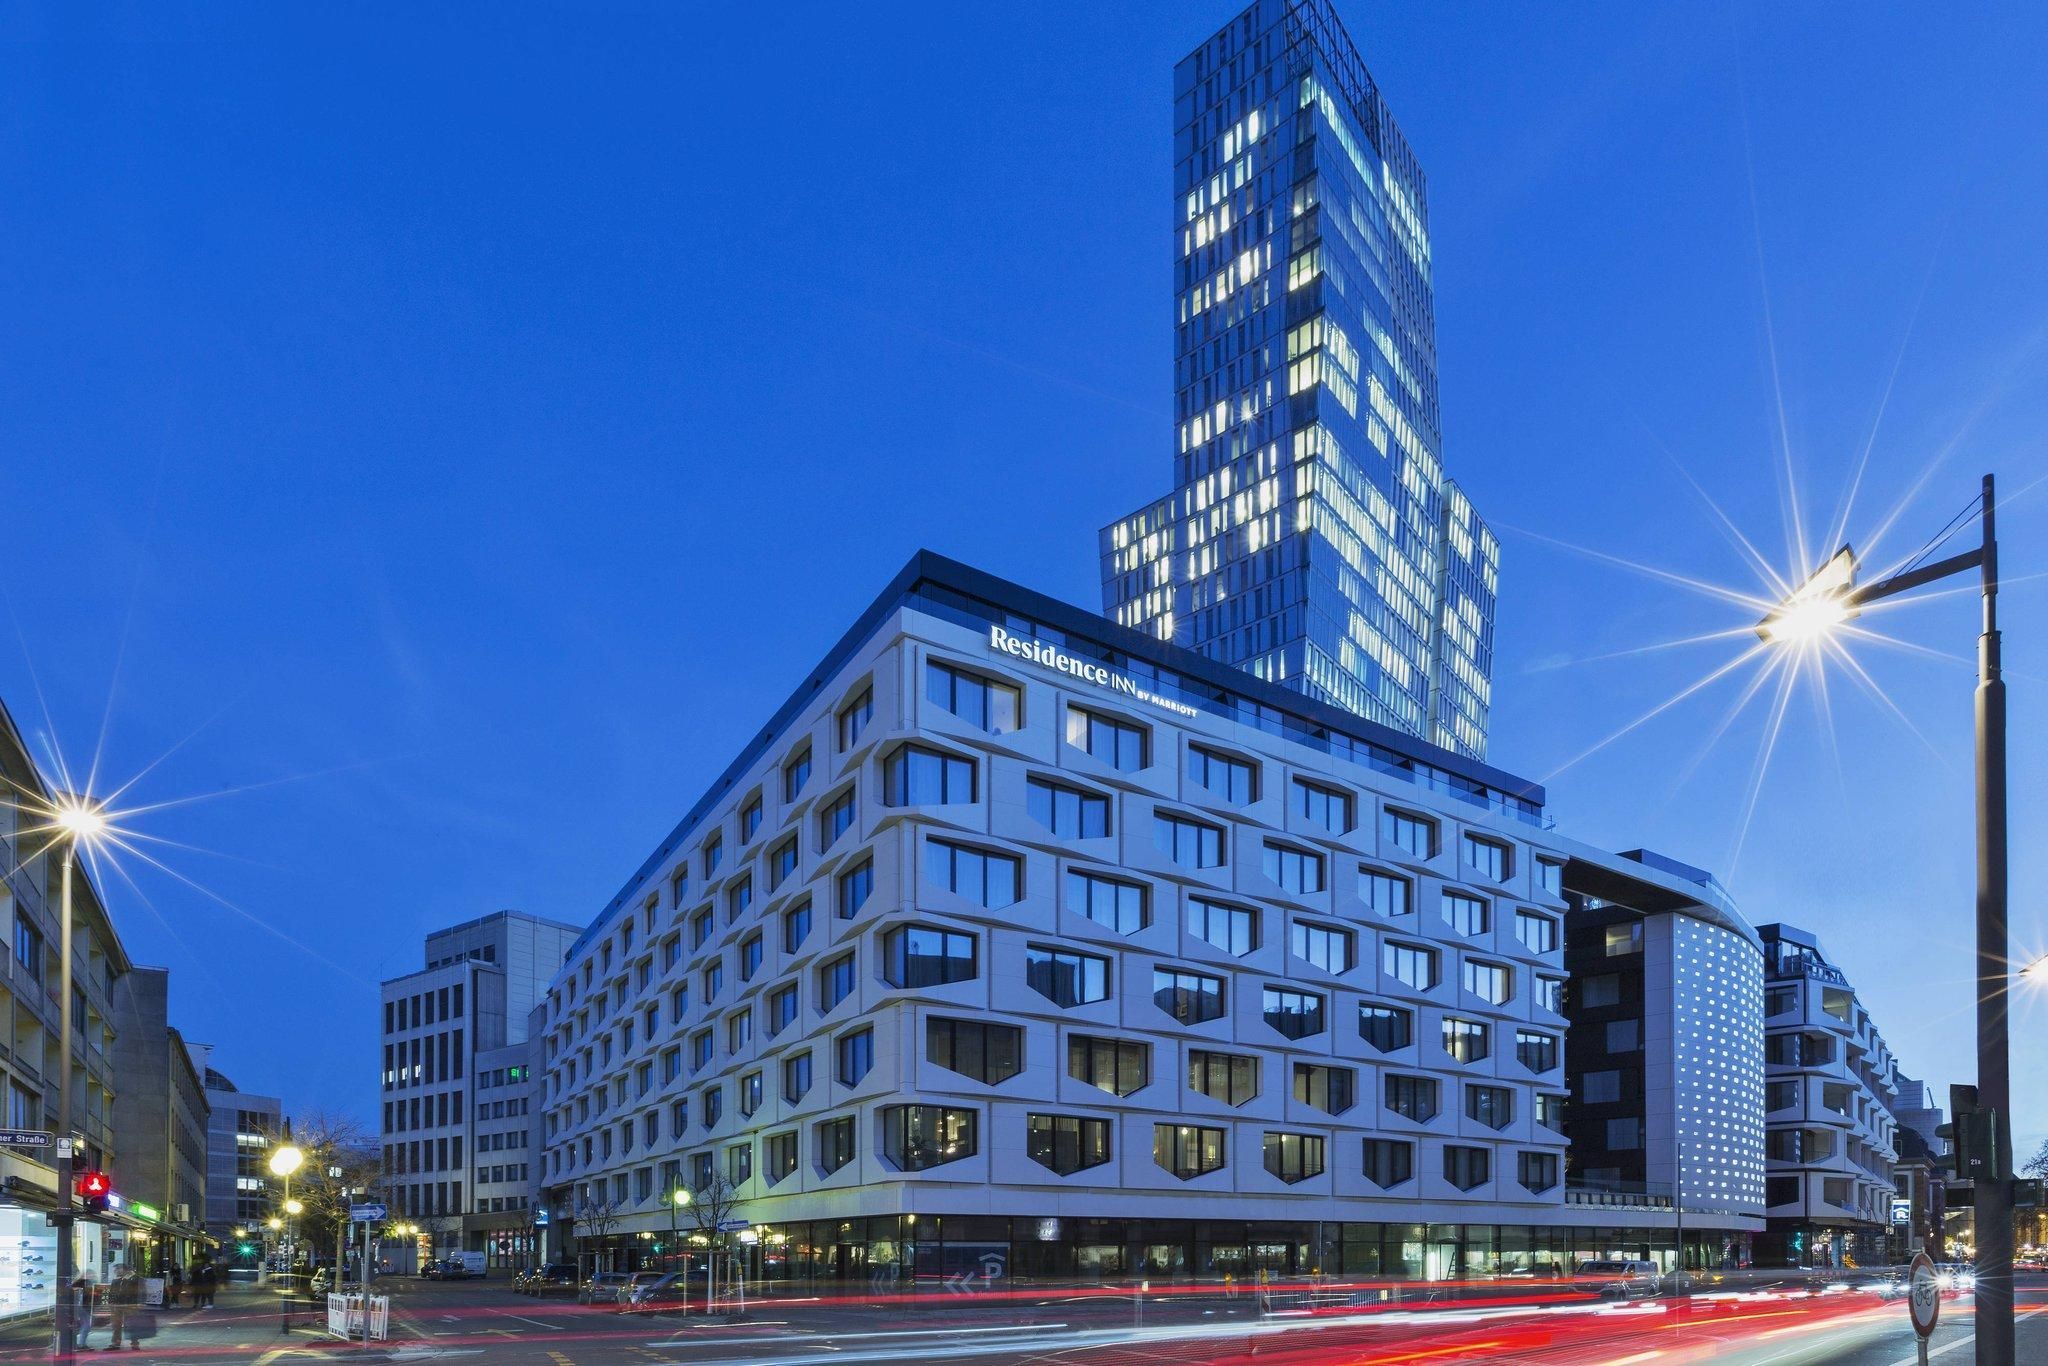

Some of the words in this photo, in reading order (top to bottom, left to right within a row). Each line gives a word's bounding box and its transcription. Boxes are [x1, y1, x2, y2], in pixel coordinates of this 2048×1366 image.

[990, 625, 1109, 685] Residence
[1111, 672, 1136, 697] INN
[1137, 690, 1150, 702] BY
[1152, 695, 1198, 718] MARRIOTT
[16, 1135, 45, 1144] Straße
[985, 1262, 1002, 1289] P
